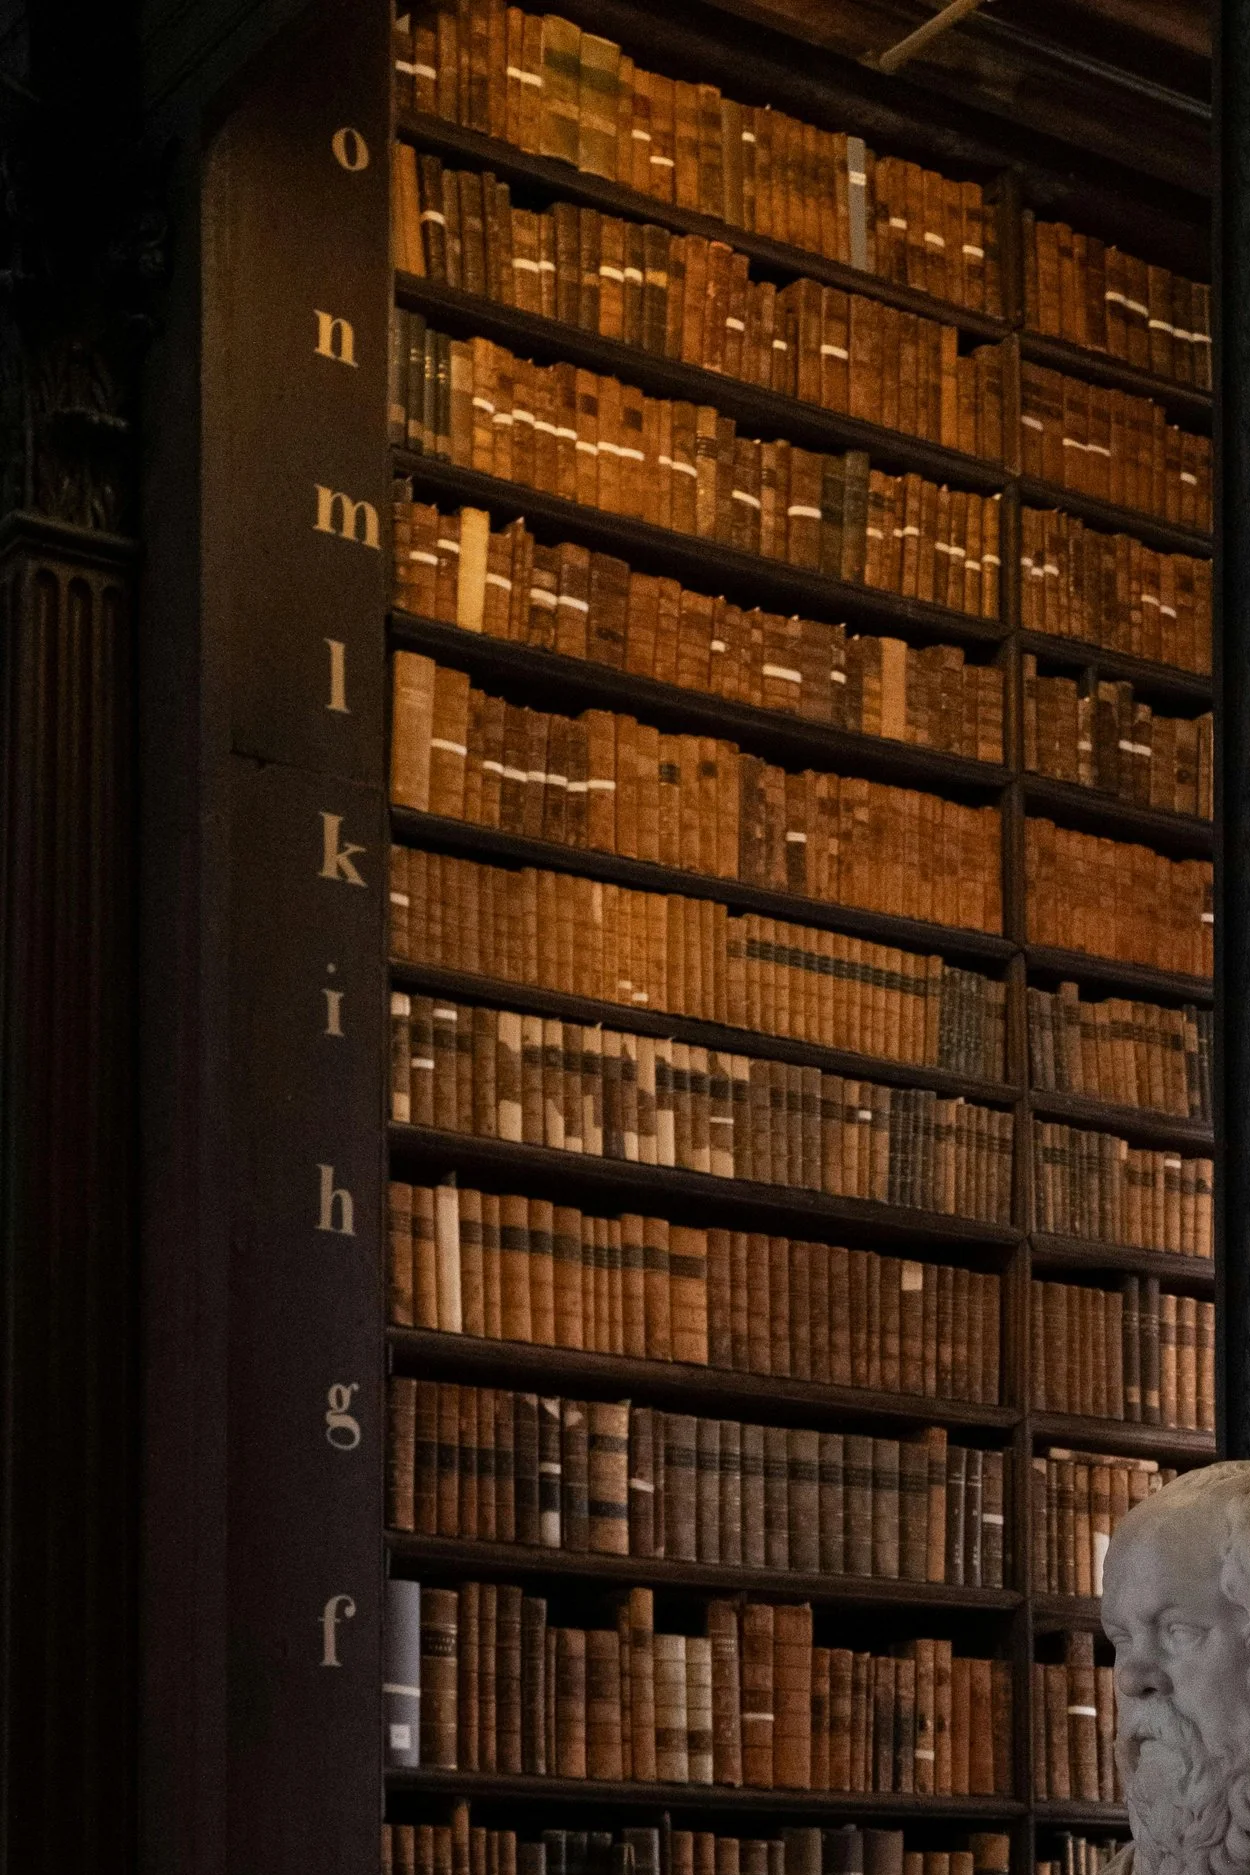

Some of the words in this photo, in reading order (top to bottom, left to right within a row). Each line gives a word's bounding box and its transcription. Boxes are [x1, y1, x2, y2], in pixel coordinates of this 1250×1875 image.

[331, 127, 371, 173] o
[314, 309, 359, 367] n
[313, 485, 381, 550] m
[318, 812, 367, 887] k
[323, 962, 344, 1036] i
[317, 1164, 356, 1236] h
[325, 1381, 361, 1452] g
[318, 1594, 358, 1668] f
